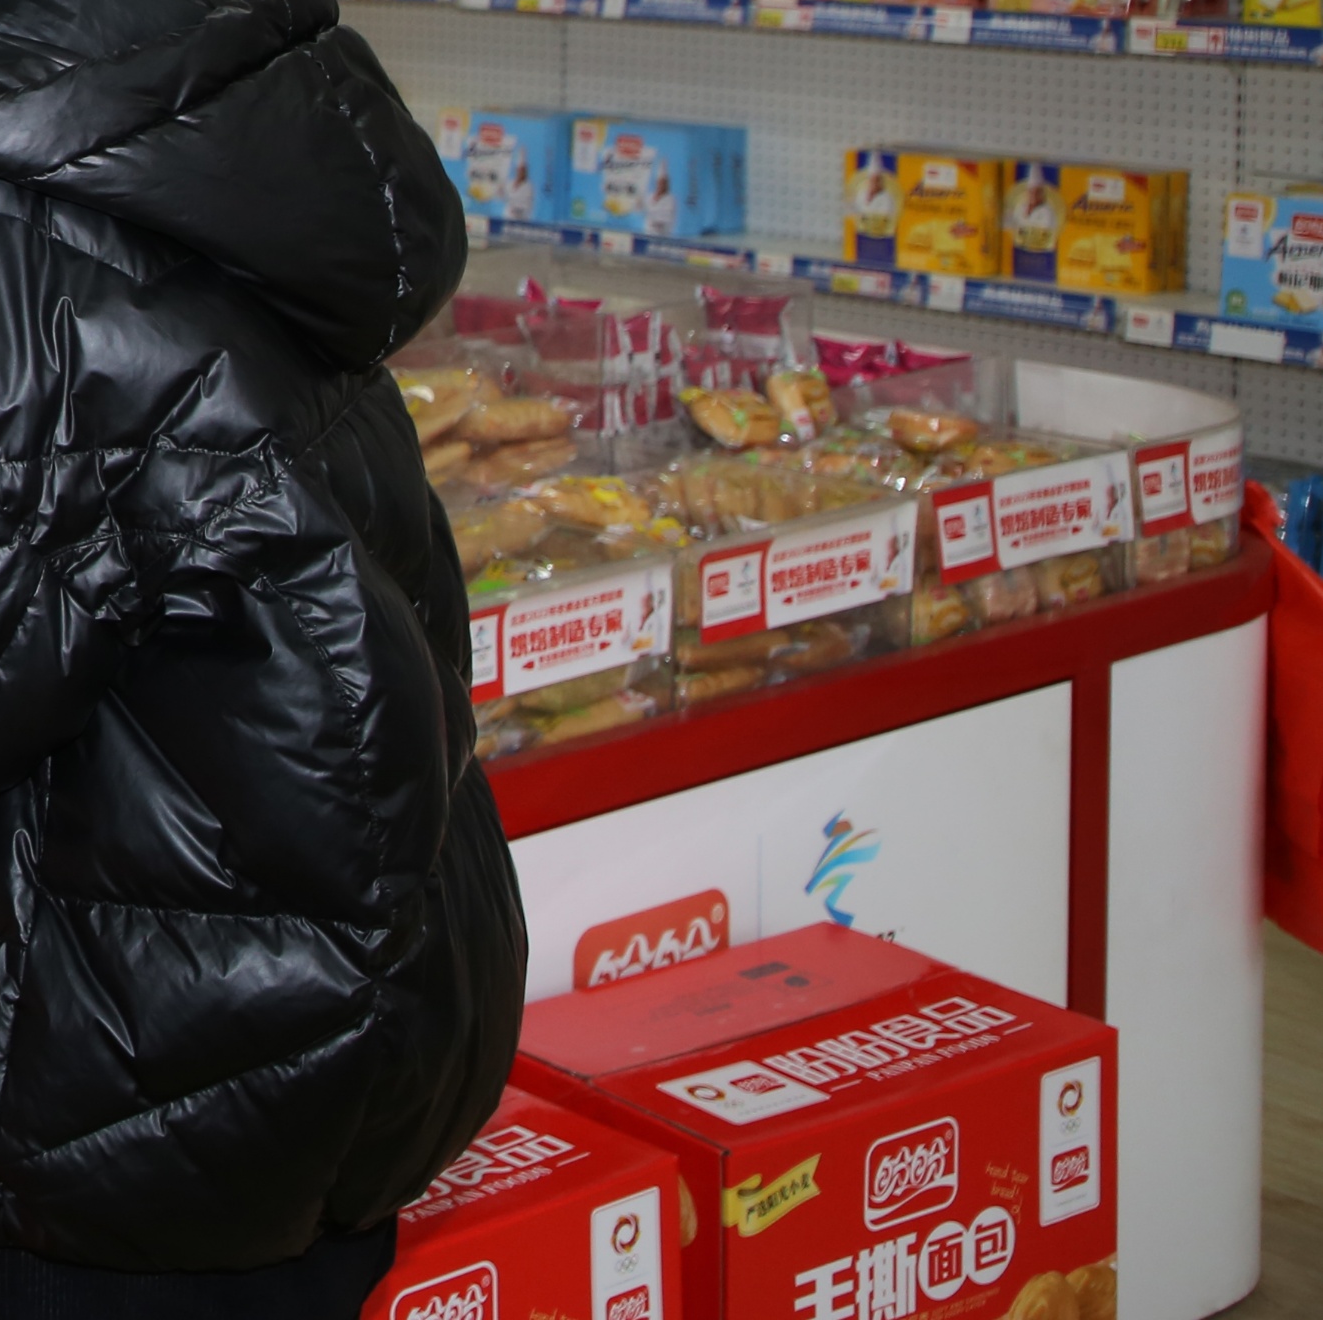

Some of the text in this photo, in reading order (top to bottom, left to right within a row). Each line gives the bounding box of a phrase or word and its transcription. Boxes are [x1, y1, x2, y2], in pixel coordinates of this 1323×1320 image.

[763, 995, 1017, 1086] 盼盼食品
[869, 1136, 951, 1203] 盼盼
